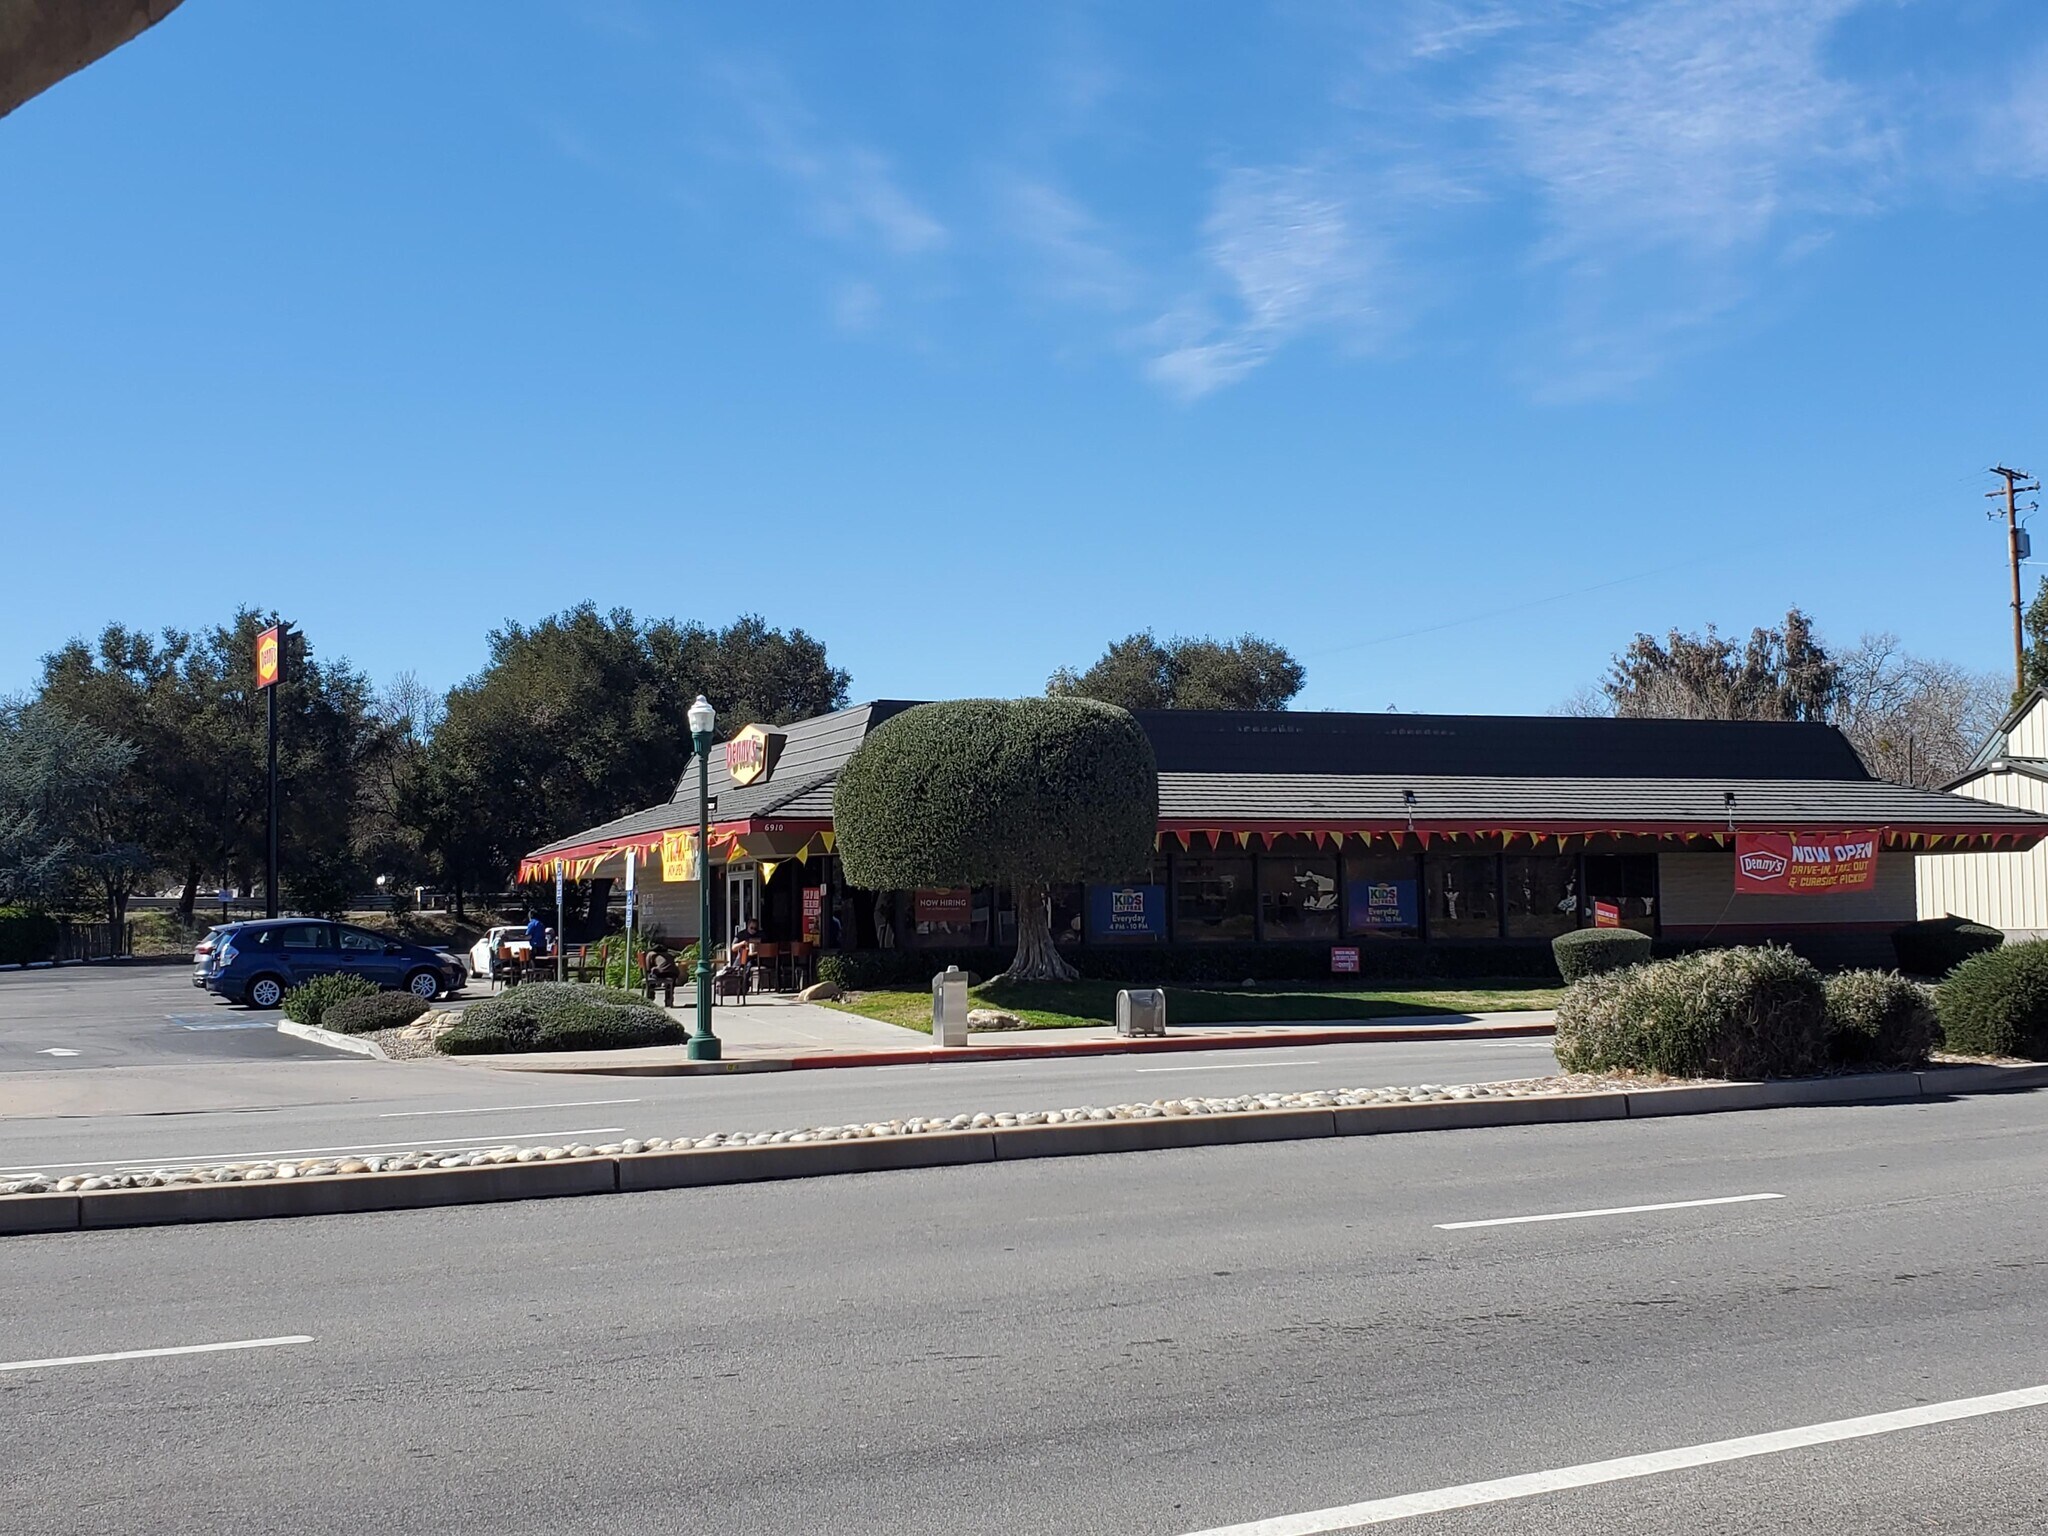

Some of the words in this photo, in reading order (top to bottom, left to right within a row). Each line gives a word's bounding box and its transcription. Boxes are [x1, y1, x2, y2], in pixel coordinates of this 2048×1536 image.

[726, 739, 757, 769] Denny's
[1792, 845, 1830, 863] NOW
[1833, 841, 1873, 862] OPEN
[1744, 857, 1783, 873] Denny's
[1791, 864, 1831, 876] DRIVE-IN,
[1834, 863, 1850, 873] TAKE
[1853, 861, 1869, 871] OUT
[1788, 876, 1797, 888] &
[1800, 875, 1837, 887] CURBSIDE
[1839, 873, 1867, 884] PICKUP
[1114, 895, 1142, 906] KIDS
[1370, 889, 1396, 899] KIDS
[1112, 914, 1146, 923] Everyday
[1368, 908, 1399, 916] Everyday
